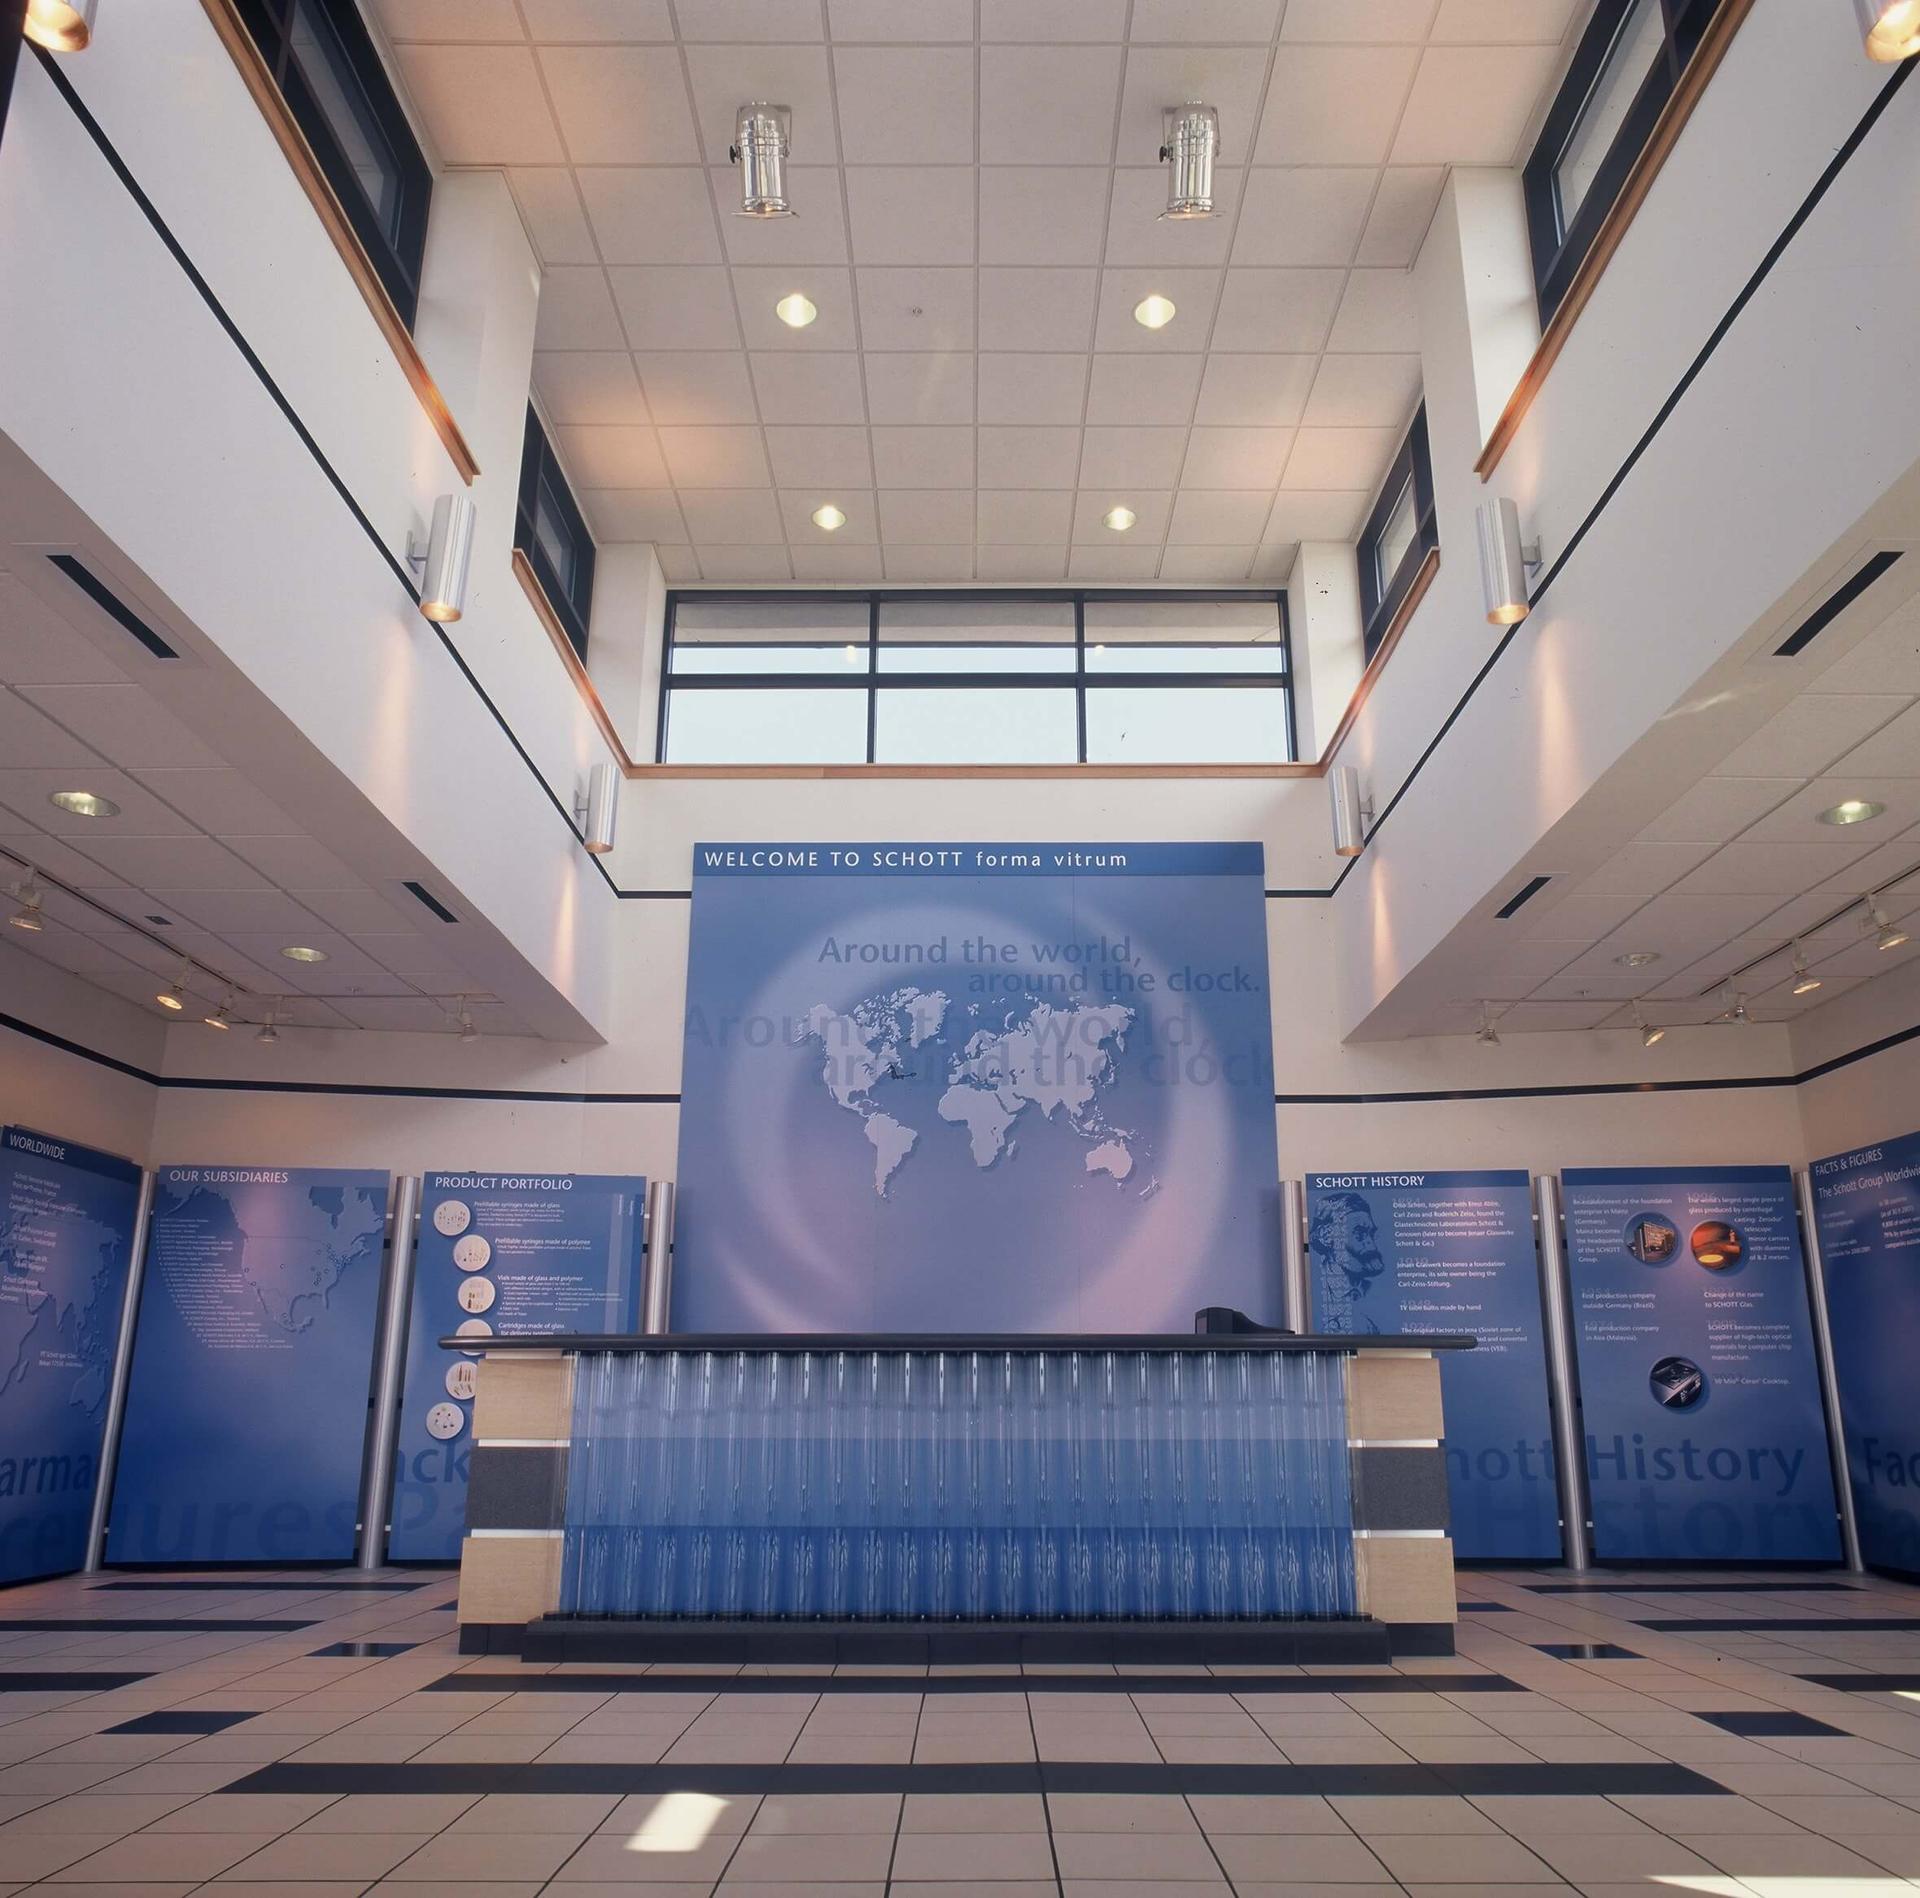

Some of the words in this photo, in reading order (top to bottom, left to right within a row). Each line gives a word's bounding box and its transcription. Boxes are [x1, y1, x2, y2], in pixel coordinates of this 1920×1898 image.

[705, 851, 819, 868] WELCOME
[831, 851, 860, 868] TO
[873, 851, 963, 868] SCHOTT
[976, 851, 1042, 868] forma
[1055, 851, 1127, 868] vitrum
[818, 936, 948, 964] Around
[961, 936, 1018, 964] the
[1031, 935, 1142, 969] world,
[968, 966, 1089, 993] around
[1100, 966, 1156, 993] the
[1167, 966, 1260, 993] clock.
[10, 1134, 65, 1160] WORLDWIDE
[1815, 1161, 1839, 1177] FACTS
[1840, 1158, 1848, 1170] &
[1849, 1148, 1883, 1167] FIGURES
[170, 1169, 199, 1184] OUR
[203, 1169, 289, 1184] SUBSIDIARIES
[435, 1176, 498, 1189] PRODUCT
[501, 1178, 573, 1190] PORTFOLIO
[1315, 1176, 1367, 1188] SCHOTT
[1371, 1175, 1425, 1187] HISTORY
[1818, 1186, 1832, 1199] The
[1833, 1180, 1857, 1196] Schott
[1858, 1174, 1884, 1189] Group
[498, 1322, 527, 1330] Cartridges
[528, 1322, 543, 1330] made
[544, 1322, 550, 1330] of
[551, 1322, 565, 1330] glass
[1588, 1432, 1804, 1496] History
